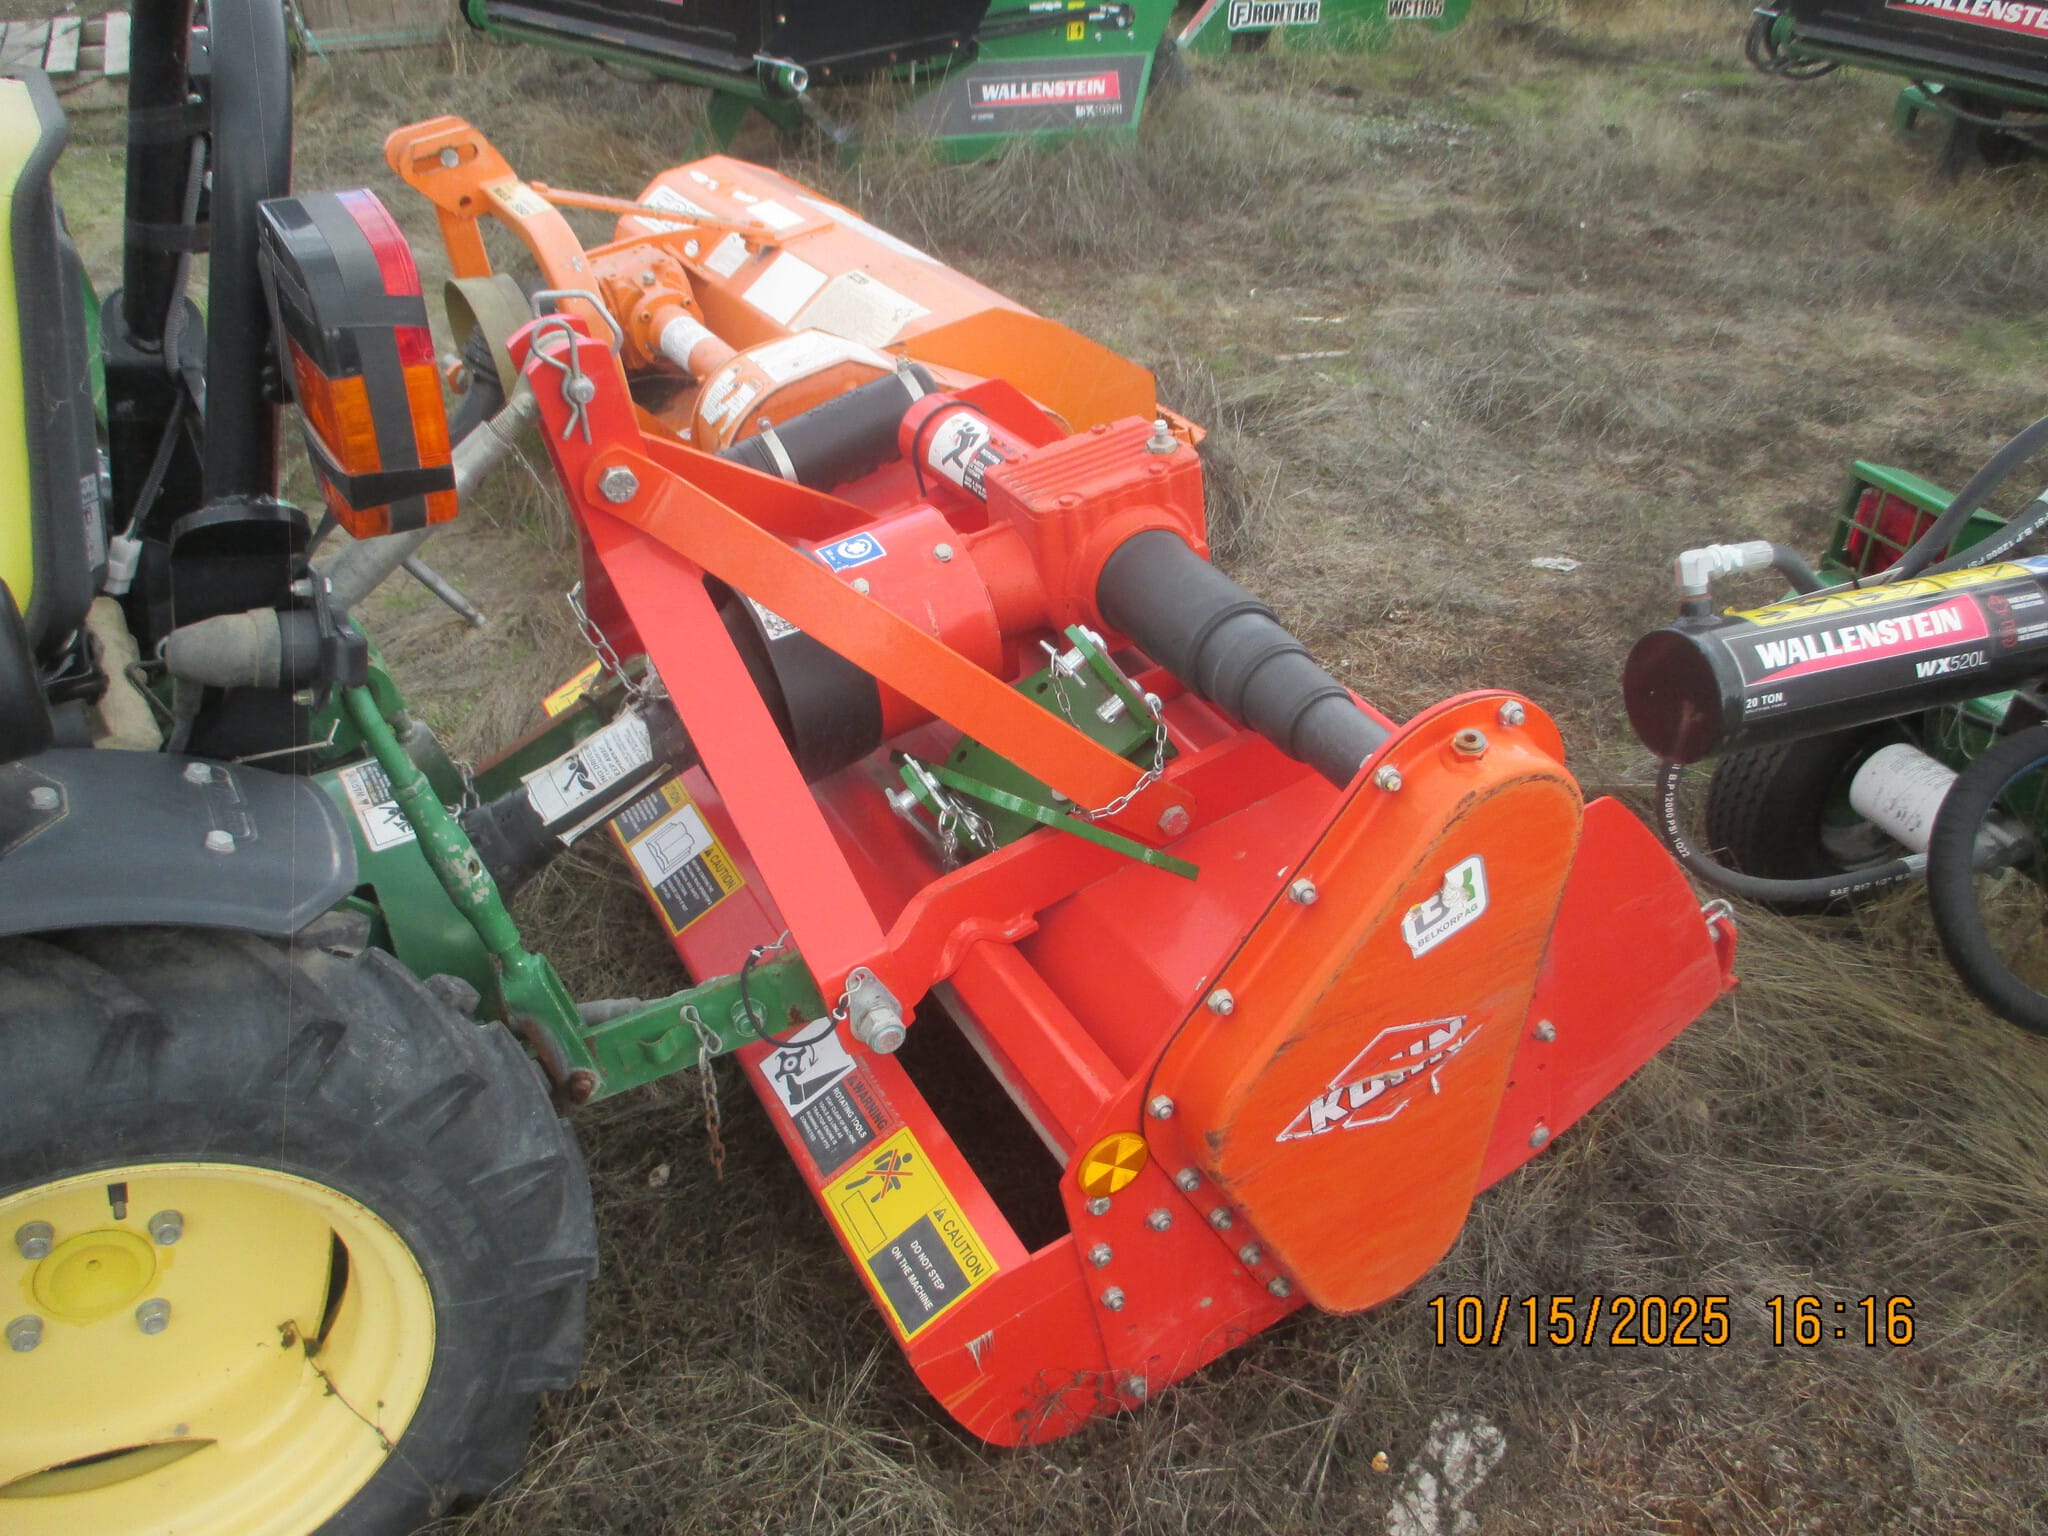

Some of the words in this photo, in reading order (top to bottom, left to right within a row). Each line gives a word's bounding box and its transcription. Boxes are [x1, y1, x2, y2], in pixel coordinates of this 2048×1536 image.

[1231, 1, 1319, 27] FRONTIER
[1389, 0, 1443, 17] WC1105
[982, 79, 1106, 102] WALLENSTEIN
[1755, 606, 1963, 669] WALLENSTEIN
[1915, 650, 1988, 679] WX520L
[1746, 698, 1758, 709] 20
[1762, 692, 1783, 704] TON
[1665, 792, 1674, 818] 12000
[1667, 819, 1679, 835] PSI
[710, 854, 736, 890] CAUTION
[1417, 912, 1464, 947] BELKORP
[1464, 903, 1478, 917] AG
[832, 1087, 855, 1119] ROTATING
[851, 1116, 867, 1139] TOOLS
[853, 1082, 889, 1131] WARNING
[910, 1240, 922, 1254] DO
[918, 1253, 933, 1271] NOT
[928, 1269, 945, 1290] STEP
[943, 1220, 984, 1278] CAUTION
[891, 1246, 903, 1260] ON
[898, 1257, 913, 1276] THE
[907, 1273, 934, 1311] MACHINE
